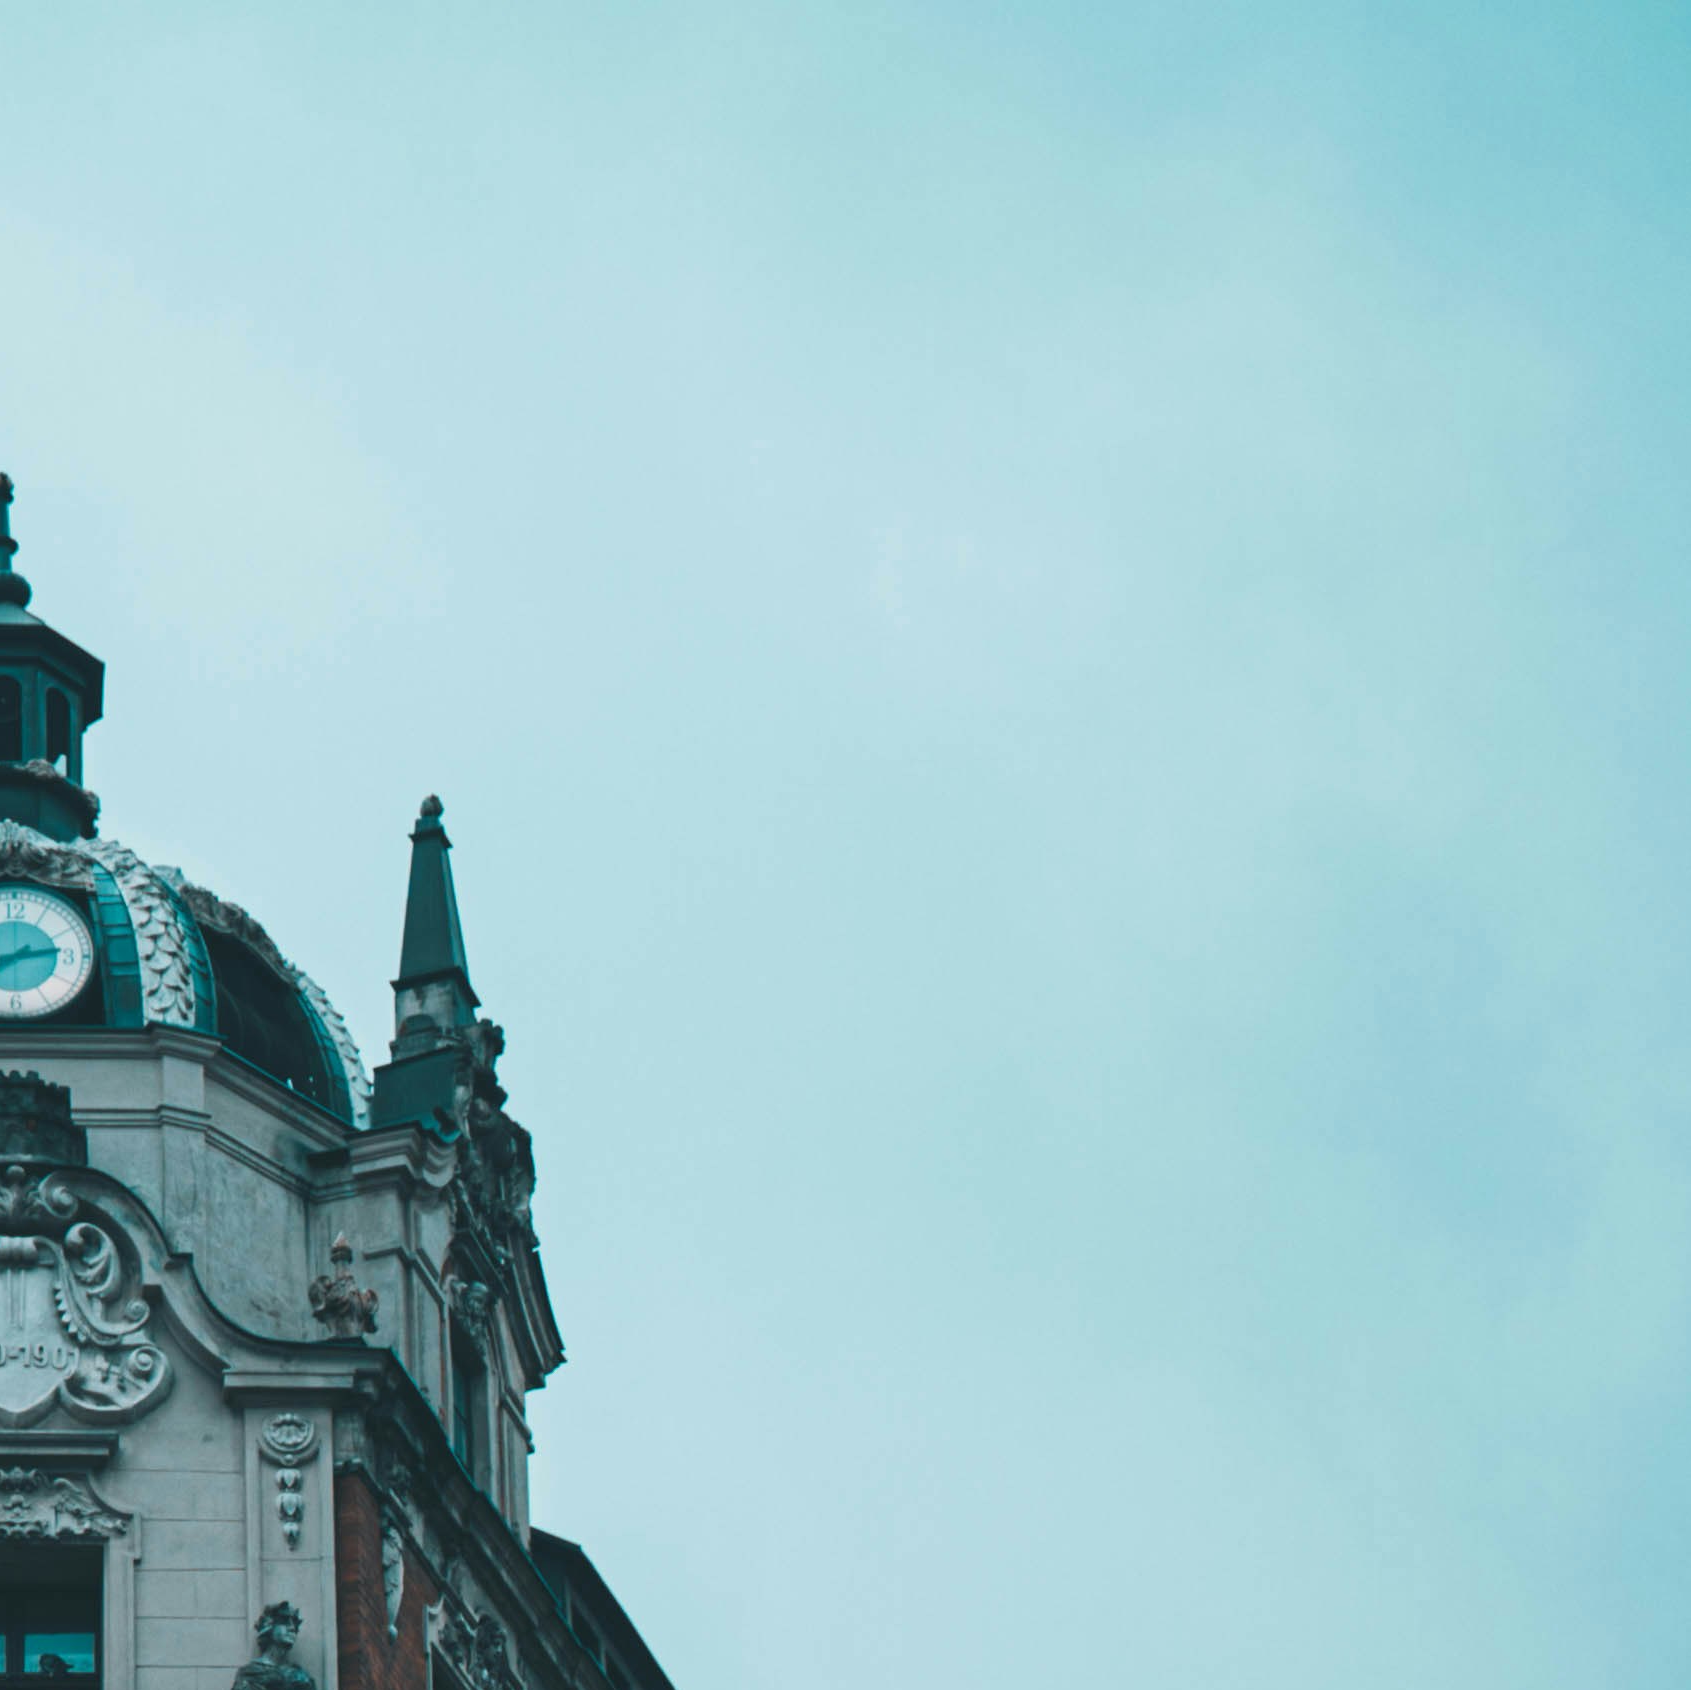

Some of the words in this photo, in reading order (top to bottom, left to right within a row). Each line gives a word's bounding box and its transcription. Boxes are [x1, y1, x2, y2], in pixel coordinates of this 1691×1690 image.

[6, 902, 26, 920] 12
[62, 947, 75, 965] 3
[9, 994, 22, 1010] 6
